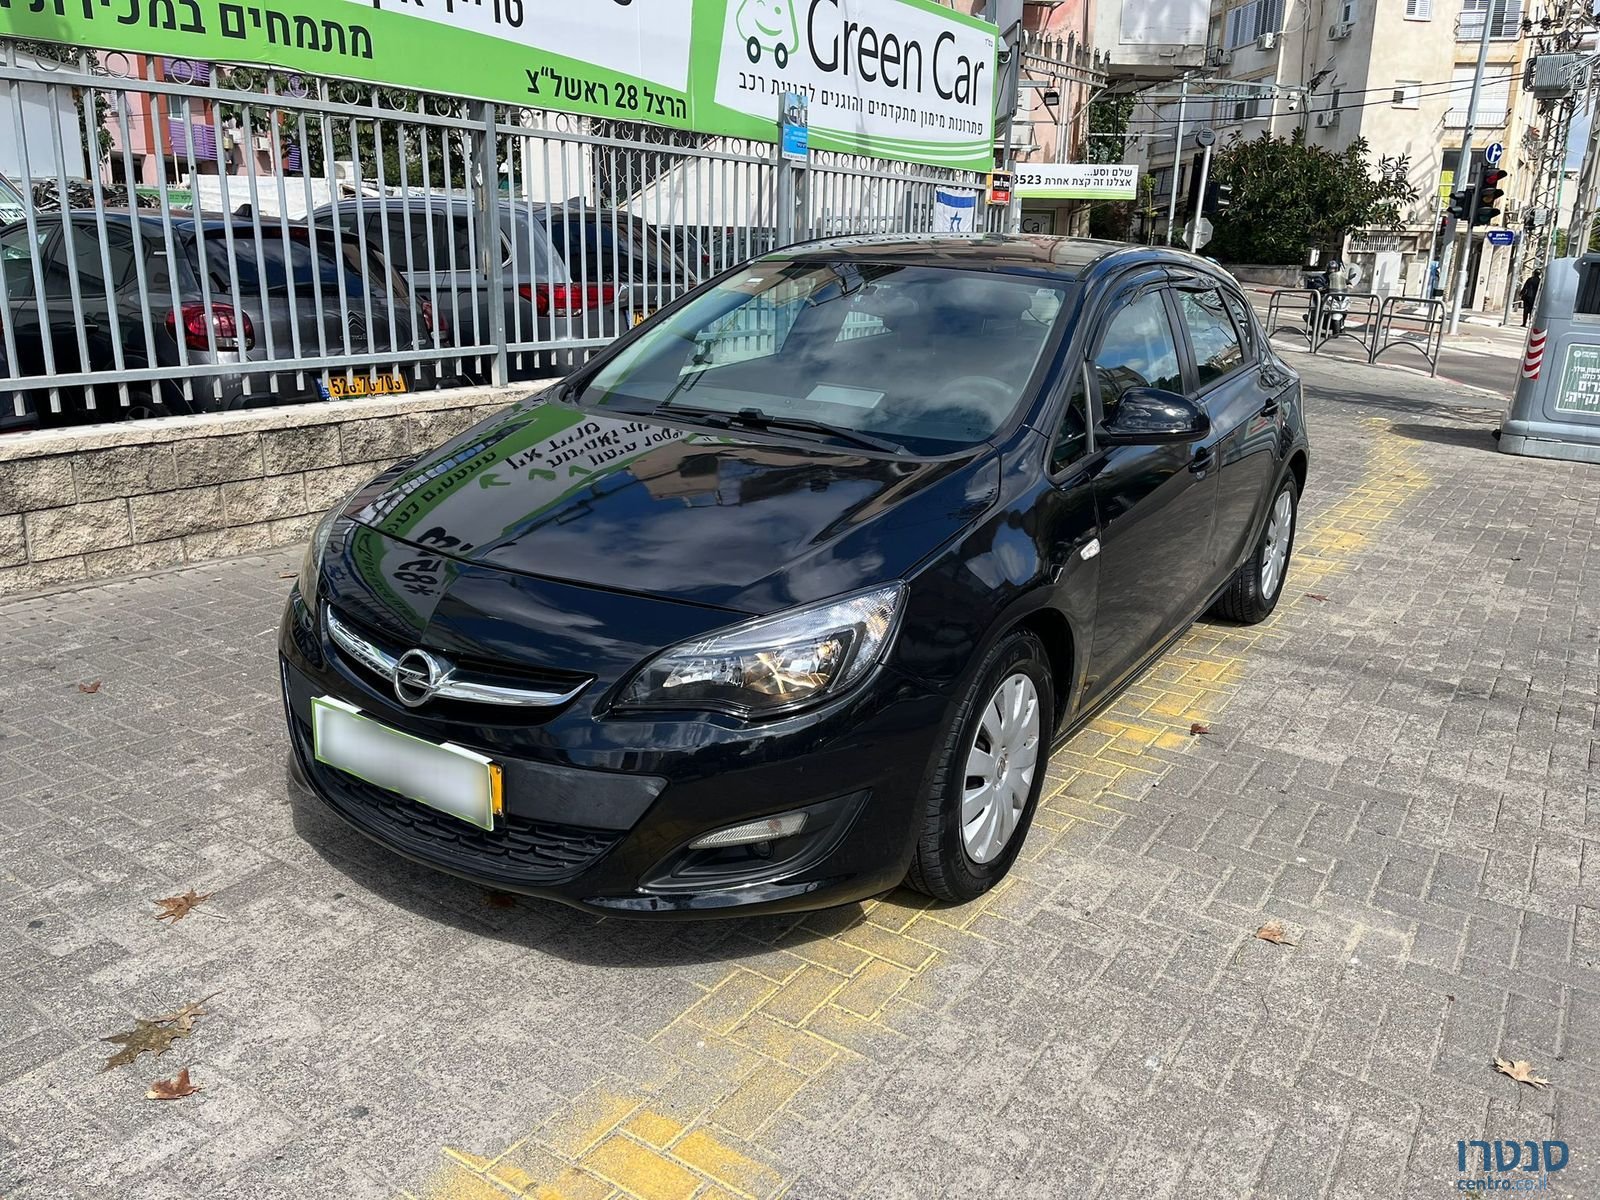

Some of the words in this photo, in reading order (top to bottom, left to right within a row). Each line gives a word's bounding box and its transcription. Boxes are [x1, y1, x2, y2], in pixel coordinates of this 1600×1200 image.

[218, 3, 373, 59] מתמחים
[807, 0, 923, 93] Green
[932, 31, 985, 106] Car
[739, 71, 765, 92] רכב
[614, 82, 639, 111] 28
[643, 86, 687, 119] הרצל
[821, 89, 863, 113] והוגנים
[868, 99, 917, 123] מתקדמים
[920, 110, 945, 128] מימון
[948, 116, 983, 136] פתרונות
[1044, 177, 1069, 186] אחרת
[1093, 178, 1103, 186] זה
[1111, 168, 1133, 177] שלם
[1071, 178, 1091, 188] קצת
[1106, 178, 1131, 187] אצלנו
[1578, 380, 1600, 392] רים
[1565, 391, 1600, 405] נקייה!
